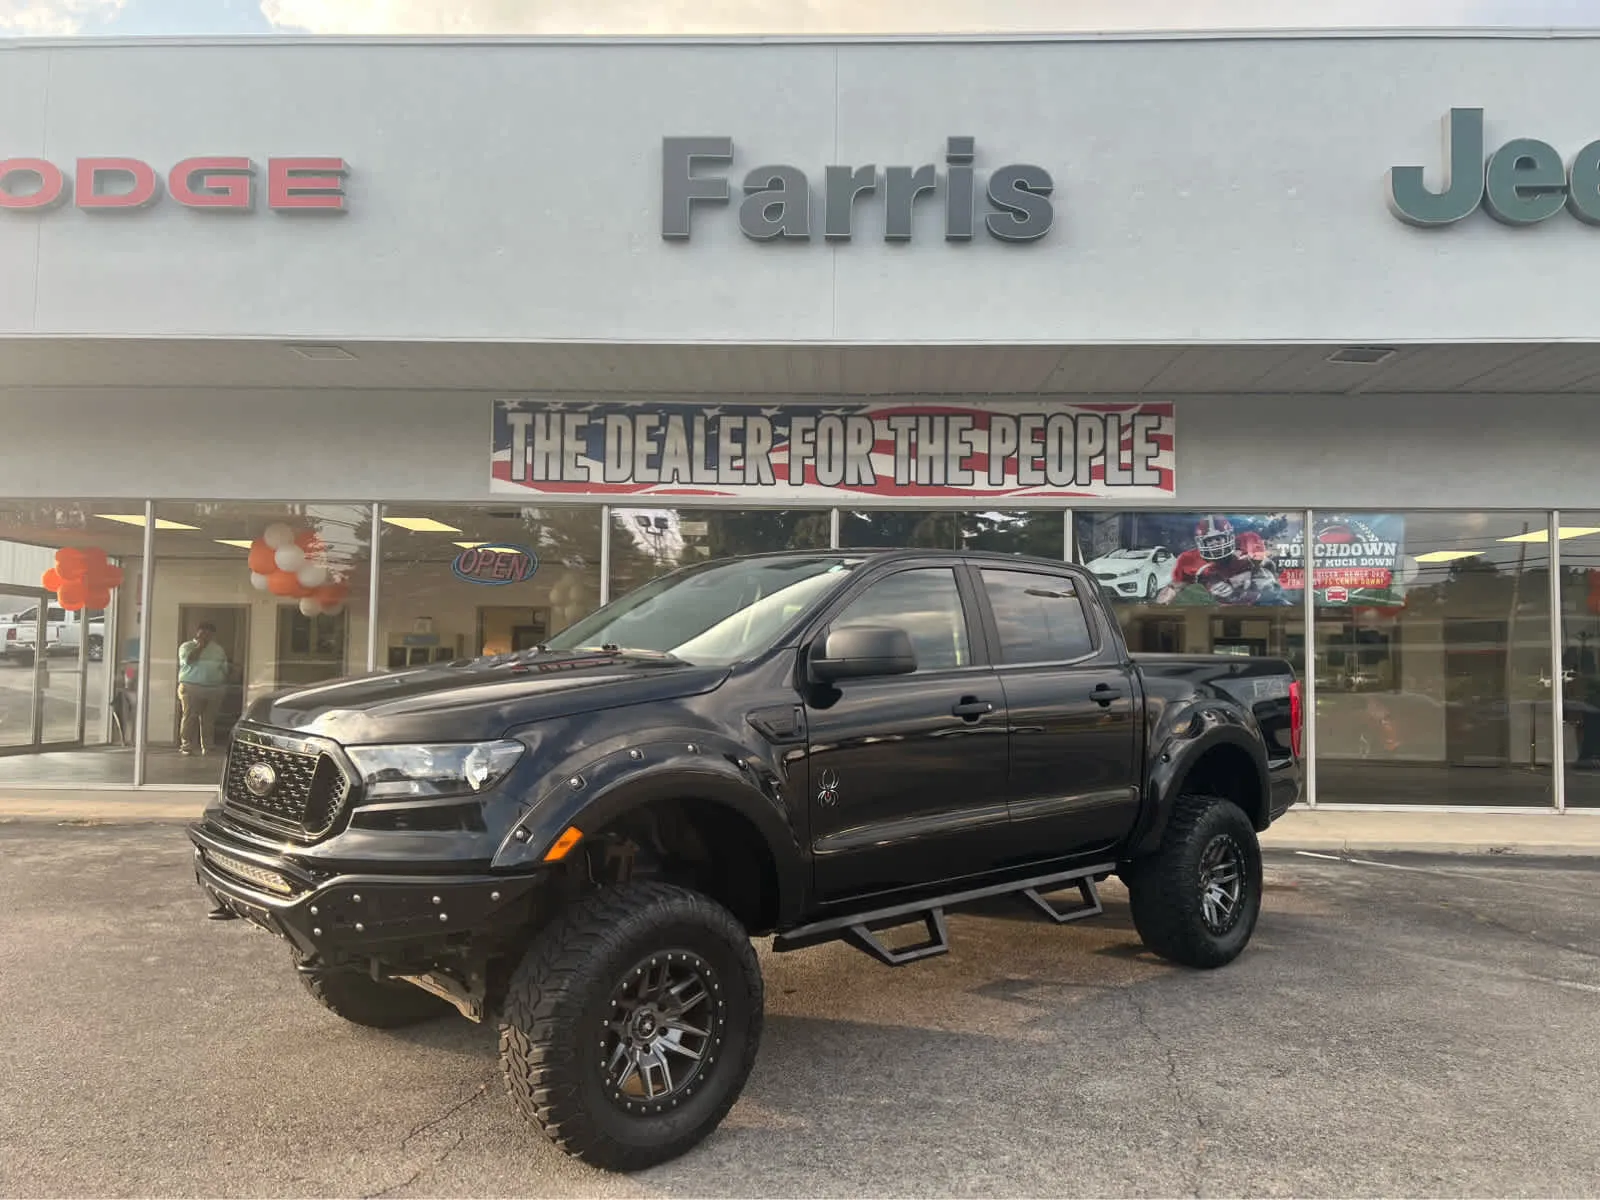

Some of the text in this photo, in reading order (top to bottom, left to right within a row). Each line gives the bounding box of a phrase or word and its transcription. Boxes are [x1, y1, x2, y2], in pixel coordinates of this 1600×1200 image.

[0, 157, 345, 209] ODGE
[662, 136, 1054, 241] Farris
[507, 412, 1161, 487] THE DEALER FOR THE PEOPLE
[460, 548, 529, 582] OPEN
[1276, 543, 1397, 557] TOCHDOWN
[1278, 559, 1298, 568] FOR
[1325, 559, 1358, 567] MUCH
[1360, 558, 1395, 568] DOWN!
